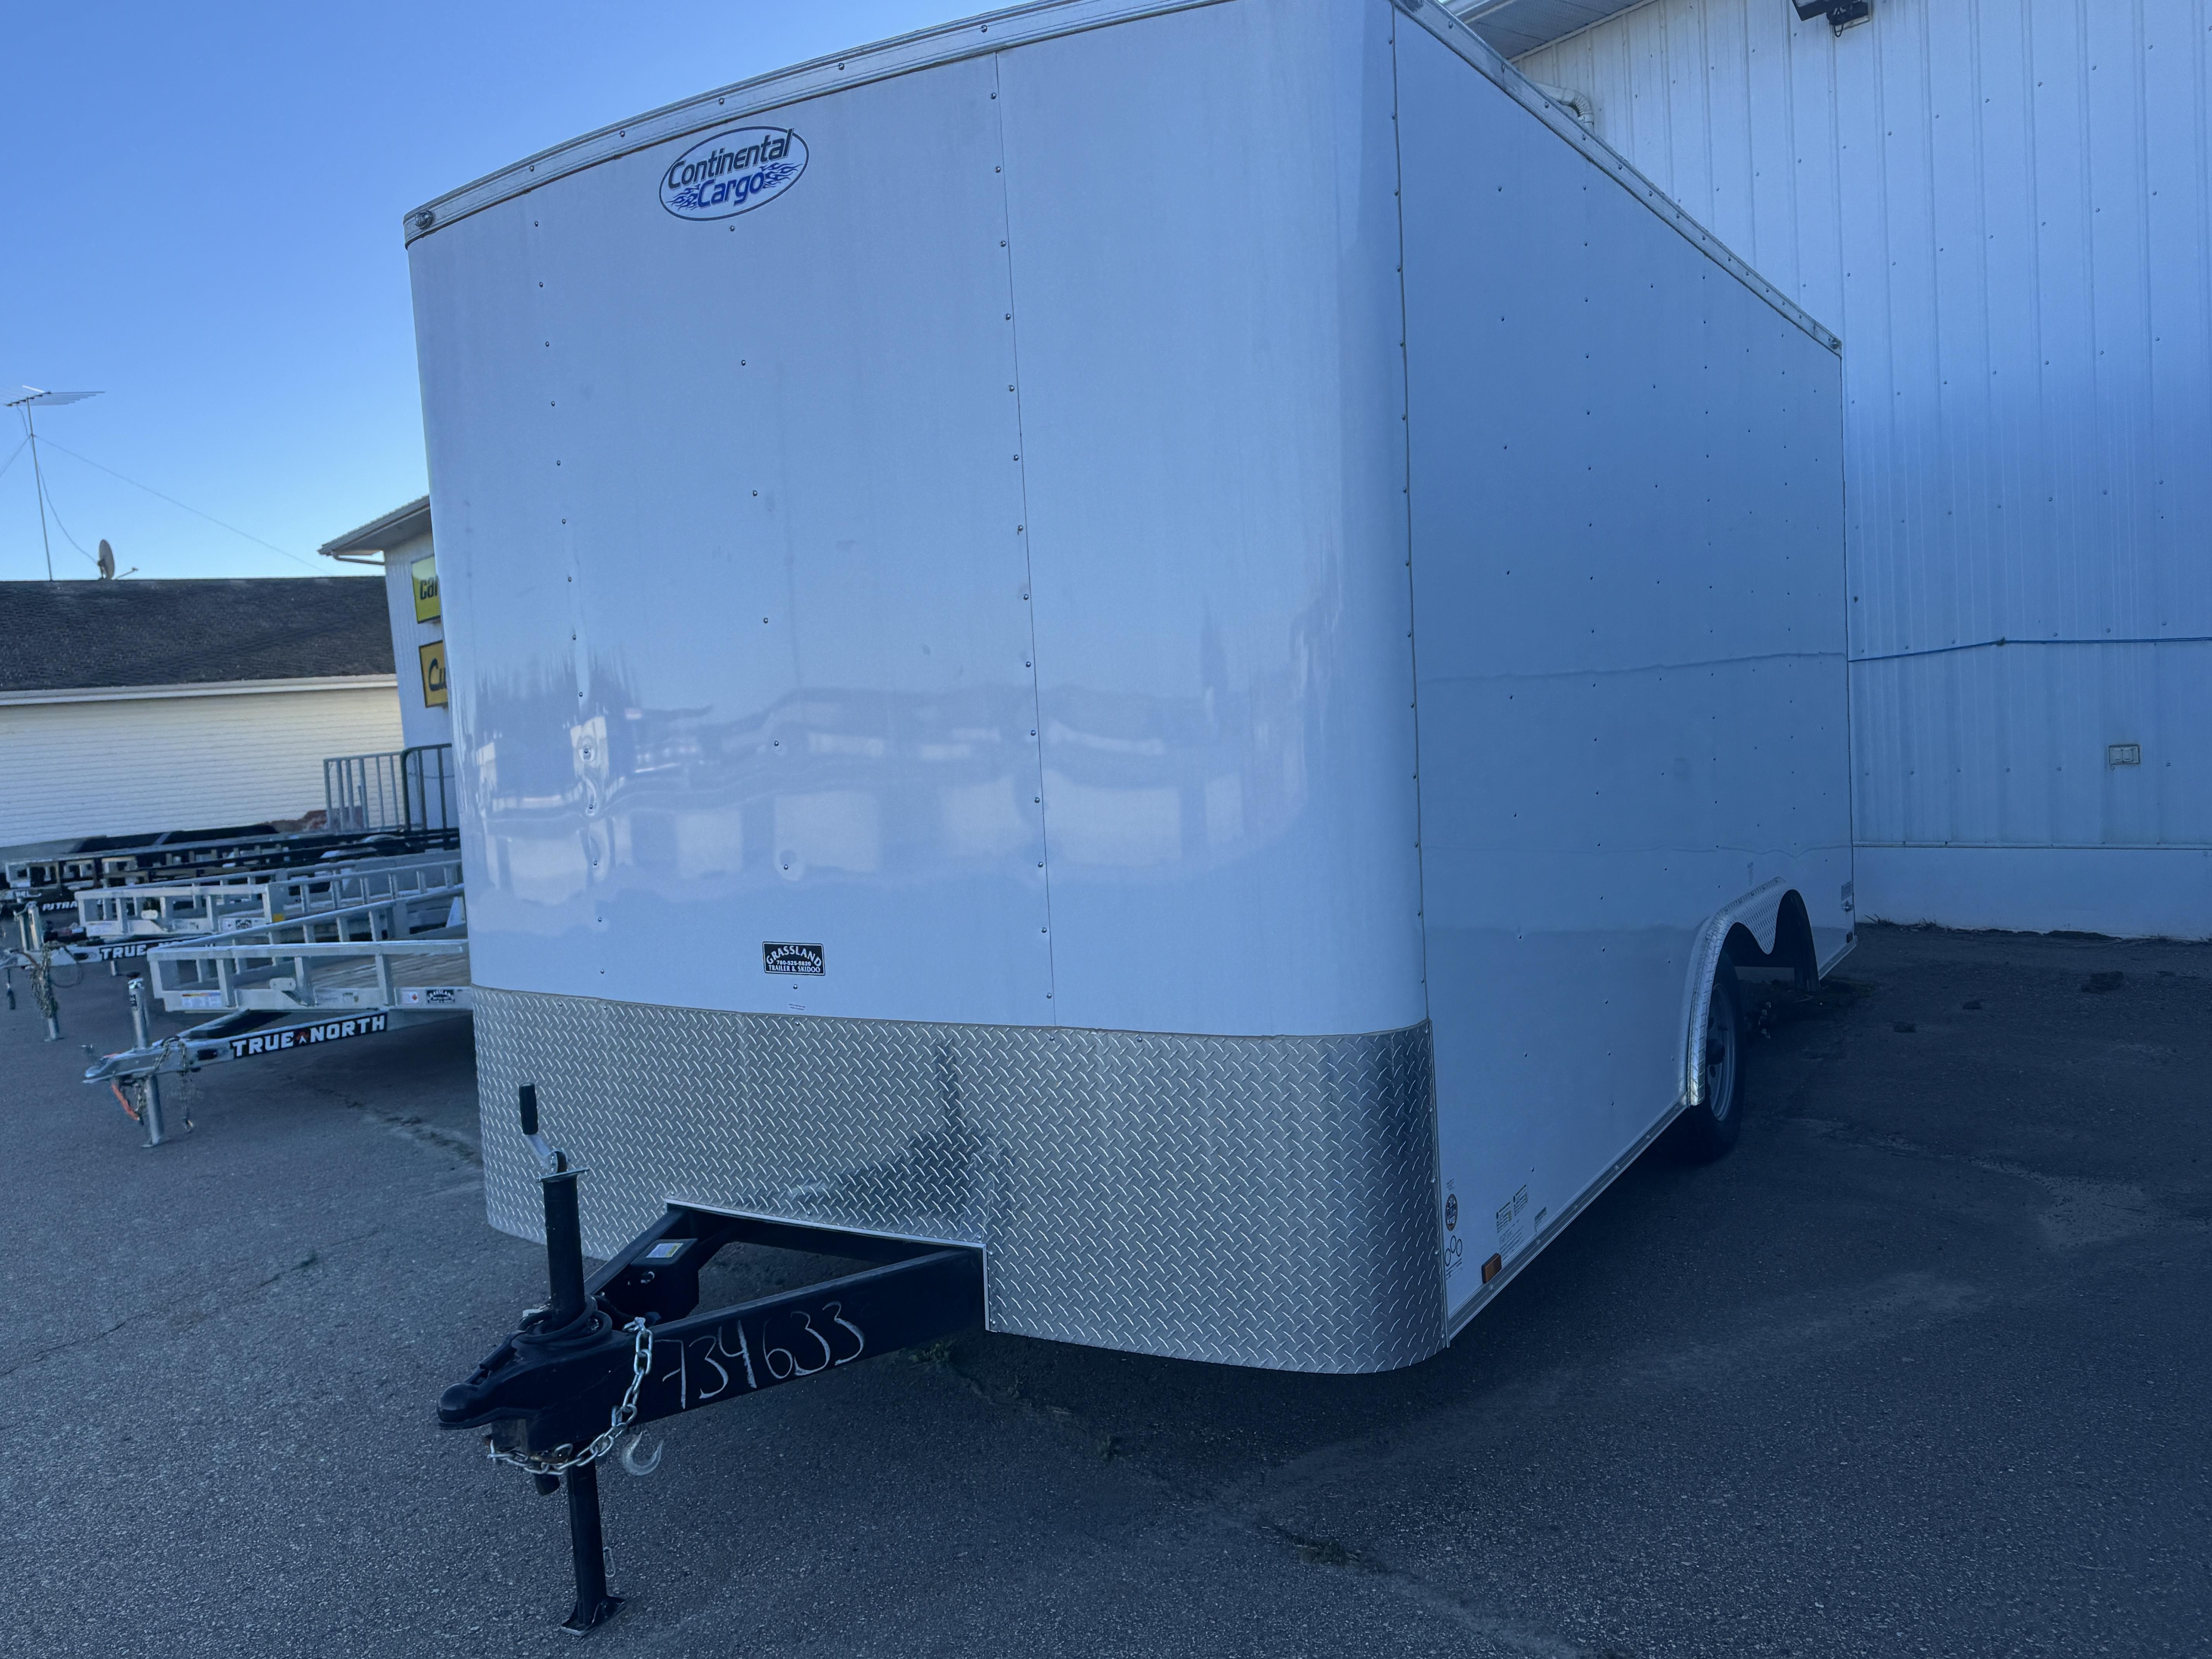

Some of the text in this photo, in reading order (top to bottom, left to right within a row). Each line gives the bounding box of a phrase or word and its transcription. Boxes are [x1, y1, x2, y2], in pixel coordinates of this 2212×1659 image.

[668, 127, 795, 189] Continental
[698, 171, 765, 208] Cargo
[101, 945, 146, 960] TRUE
[766, 945, 822, 966] GRASSLAND
[232, 1015, 385, 1057] TRUE NORTH
[654, 1301, 866, 1409] 734633
